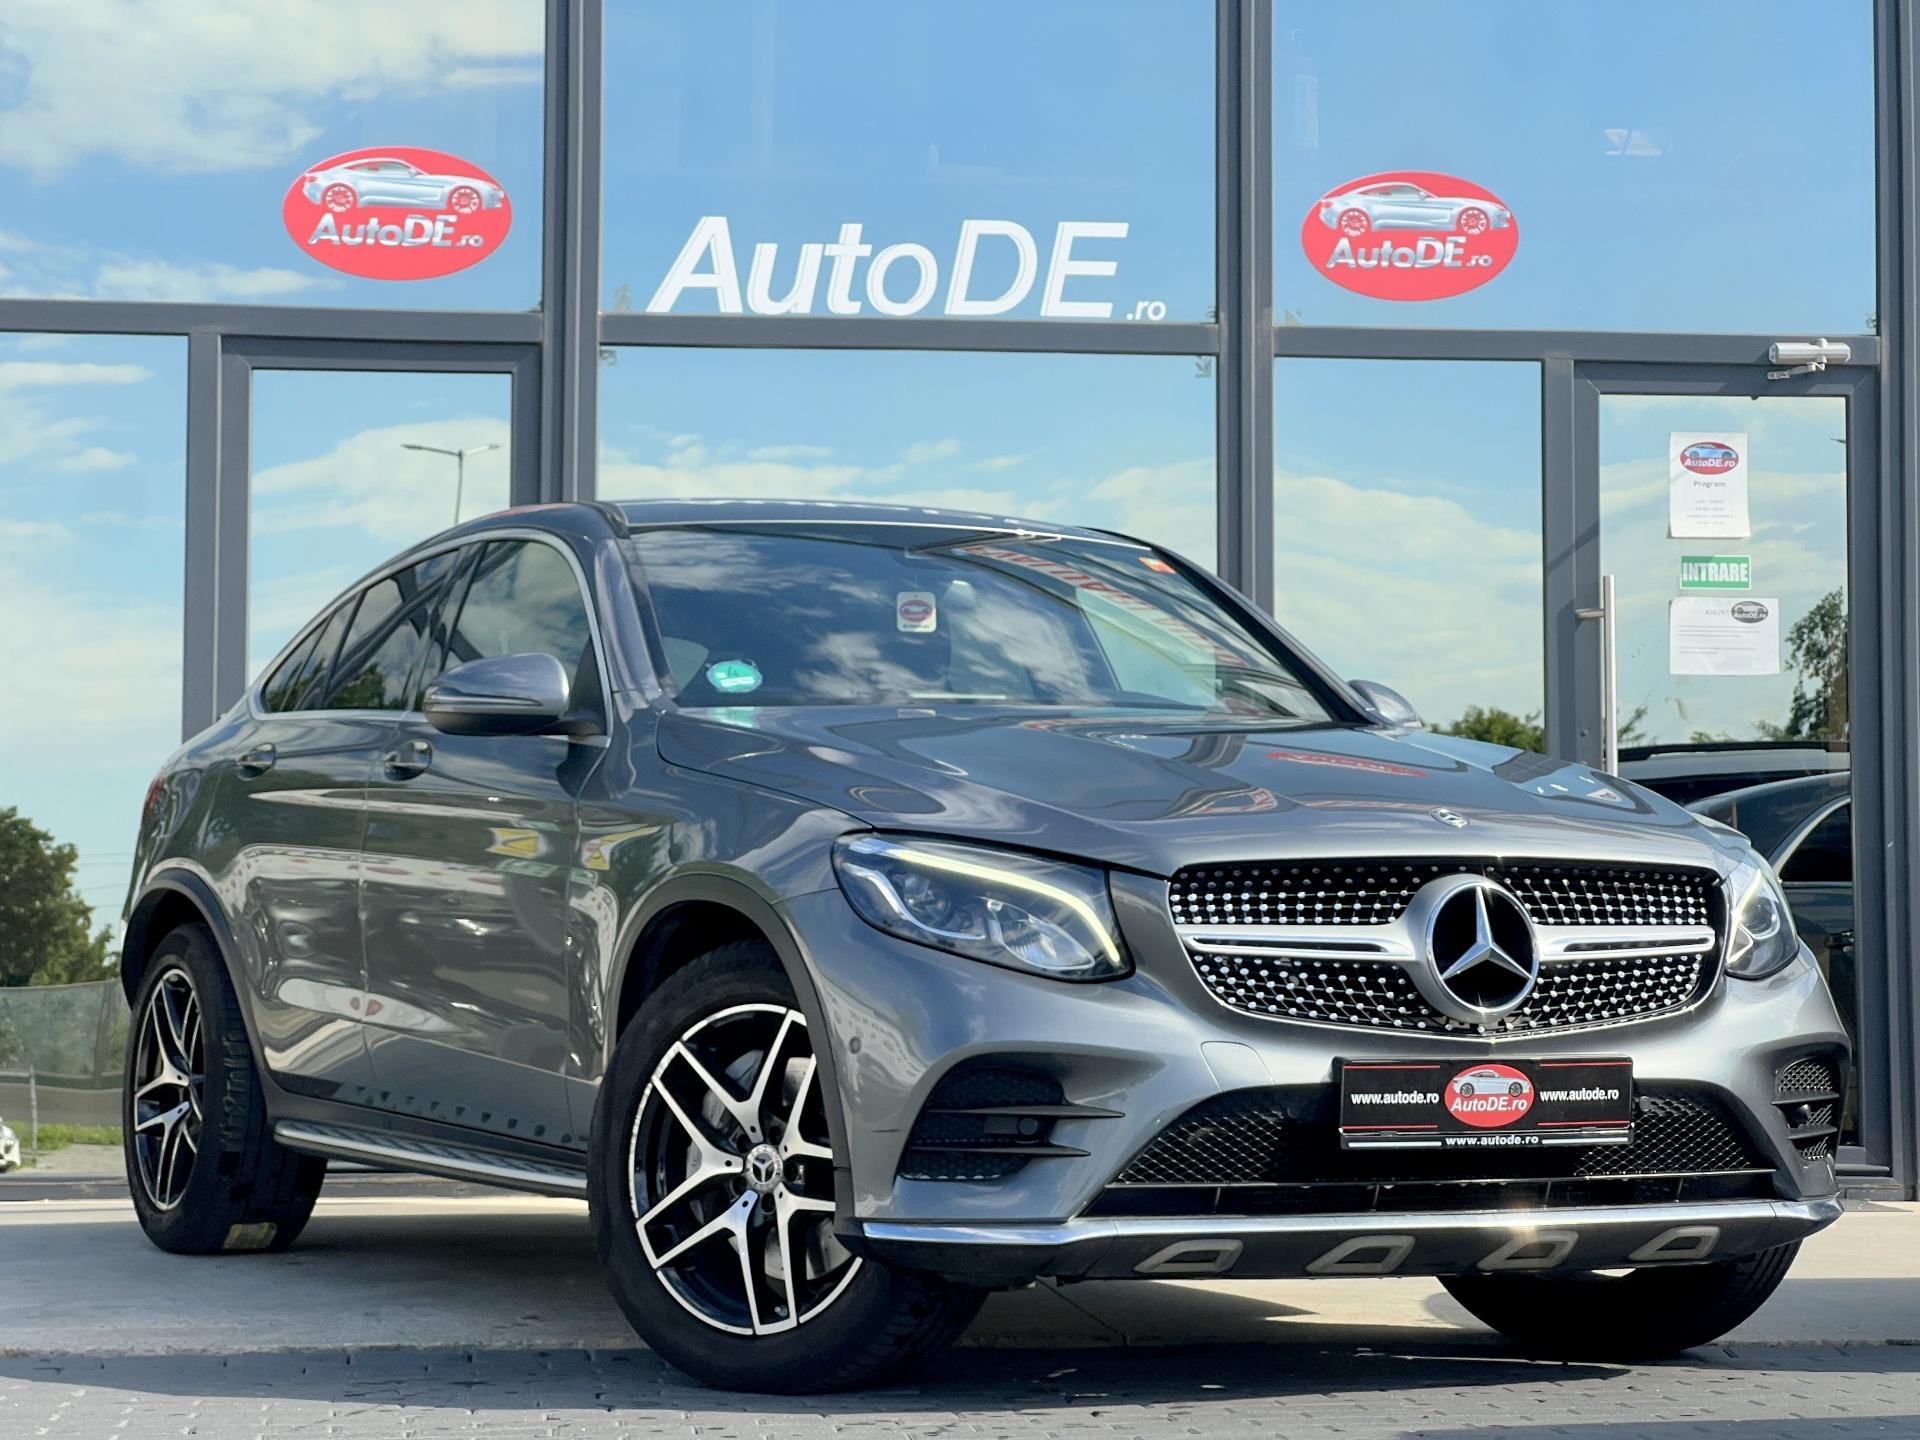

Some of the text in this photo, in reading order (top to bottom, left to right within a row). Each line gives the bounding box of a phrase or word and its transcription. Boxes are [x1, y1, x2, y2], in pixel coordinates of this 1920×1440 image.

[1684, 457, 1736, 468] AutoDE.ro
[1693, 480, 1726, 488] Program
[1682, 562, 1748, 582] INTRARE
[1351, 1090, 1440, 1105] www.autode.ro
[1540, 1087, 1620, 1102] www.autode.ro
[1451, 1097, 1528, 1113] AutoDE.ro
[1445, 1135, 1539, 1146] www.autode.ro
